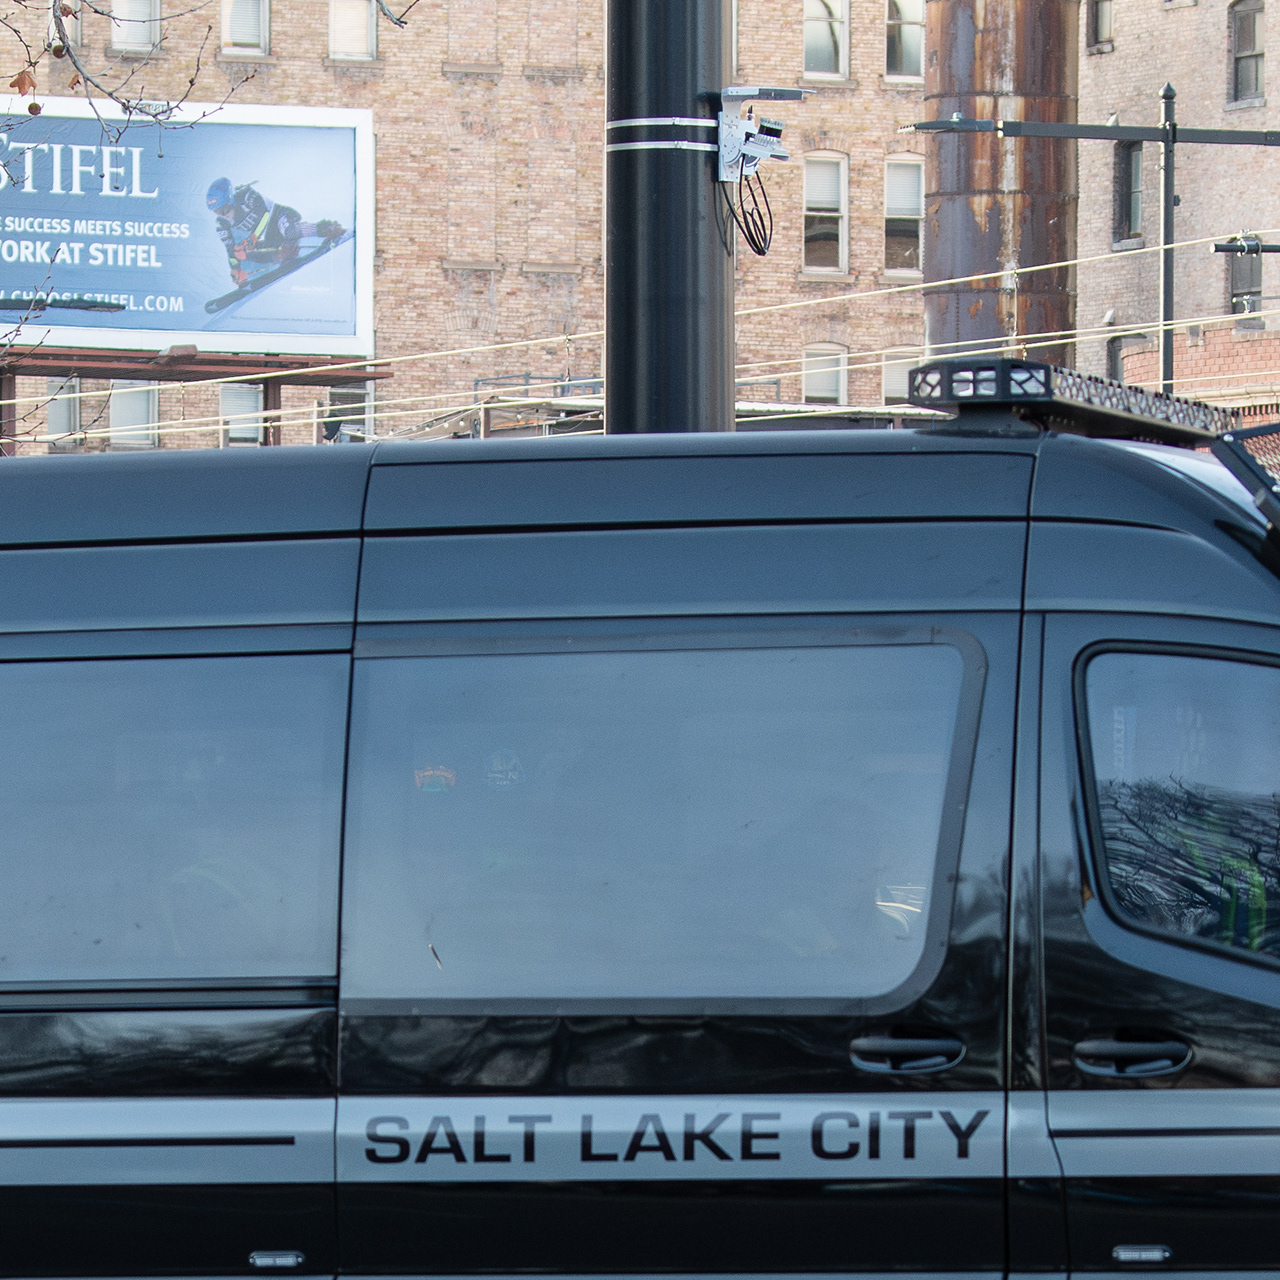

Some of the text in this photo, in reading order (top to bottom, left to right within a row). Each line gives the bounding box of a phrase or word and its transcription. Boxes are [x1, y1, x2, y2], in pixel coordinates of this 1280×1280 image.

[4, 216, 71, 234] SUCCESS
[74, 219, 121, 237] MEETS
[124, 221, 190, 239] SUCCESS
[58, 241, 84, 265] AT
[89, 243, 162, 268] STIFEL
[365, 1109, 991, 1164] SALT LAKE CITY
